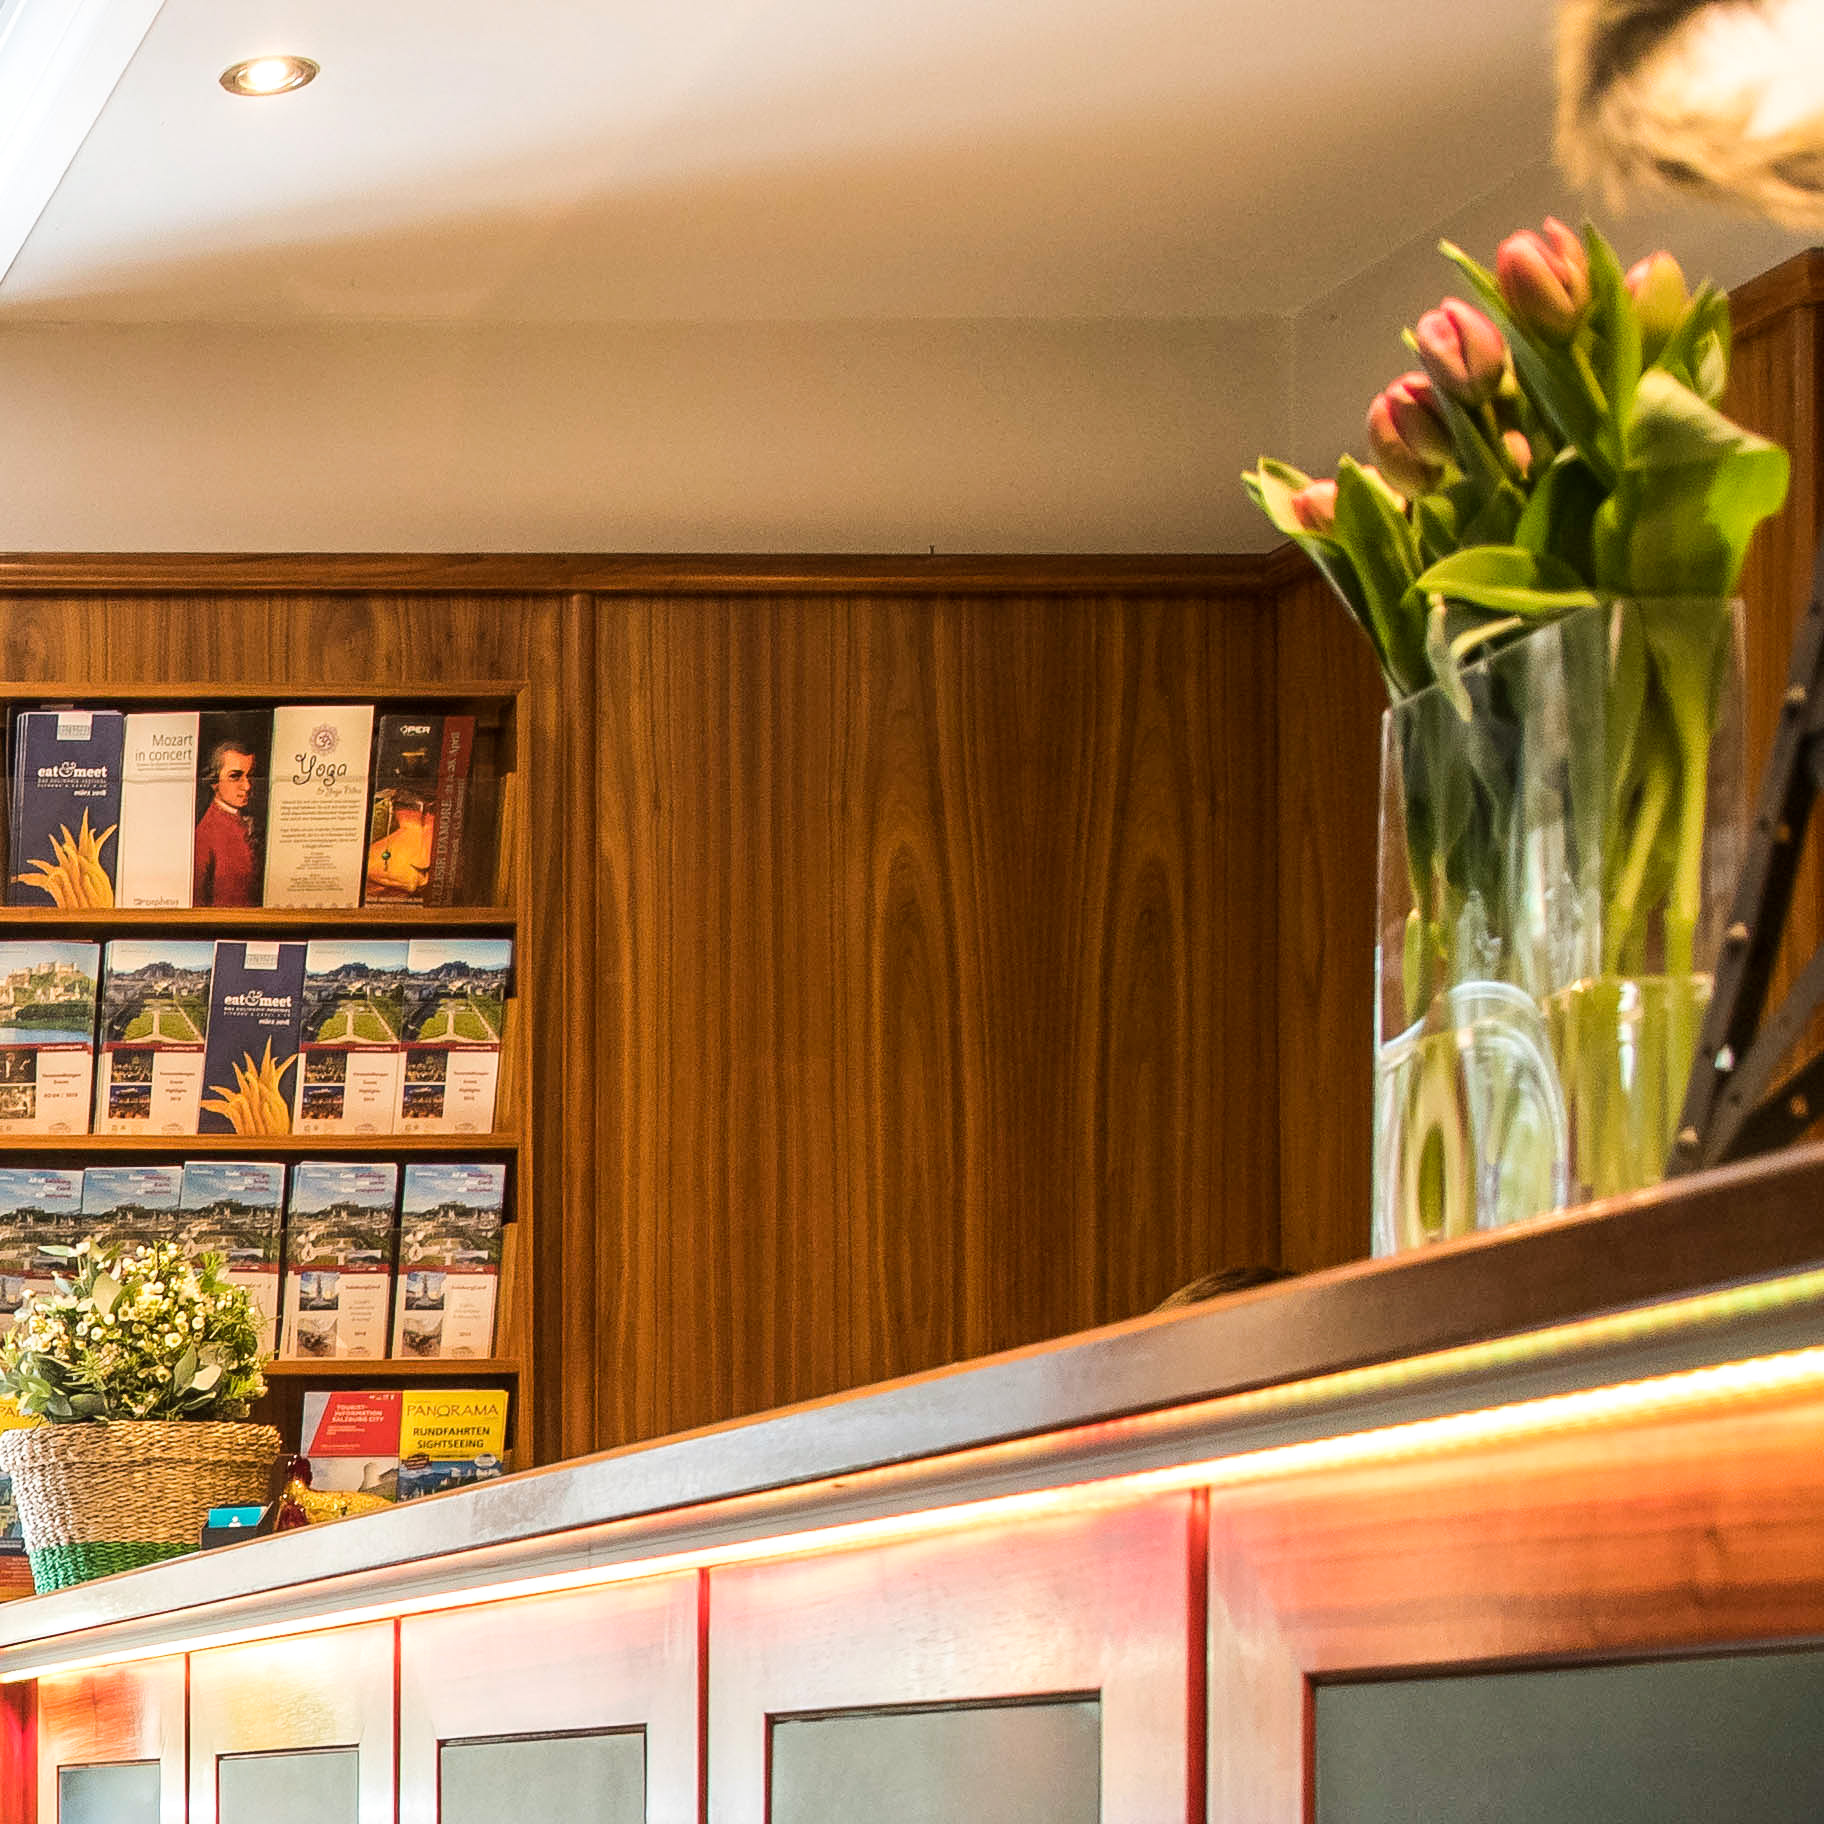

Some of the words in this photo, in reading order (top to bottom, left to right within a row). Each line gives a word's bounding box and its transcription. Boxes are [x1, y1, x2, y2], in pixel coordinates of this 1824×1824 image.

[152, 733, 193, 747] Mozart
[135, 750, 146, 761] in
[148, 749, 192, 761] concert
[292, 752, 348, 787] Yoga
[407, 1404, 499, 1418] PANORAMA
[413, 1426, 490, 1436] RUNDFAHRTEN
[417, 1439, 484, 1449] SIGHTSEEING
